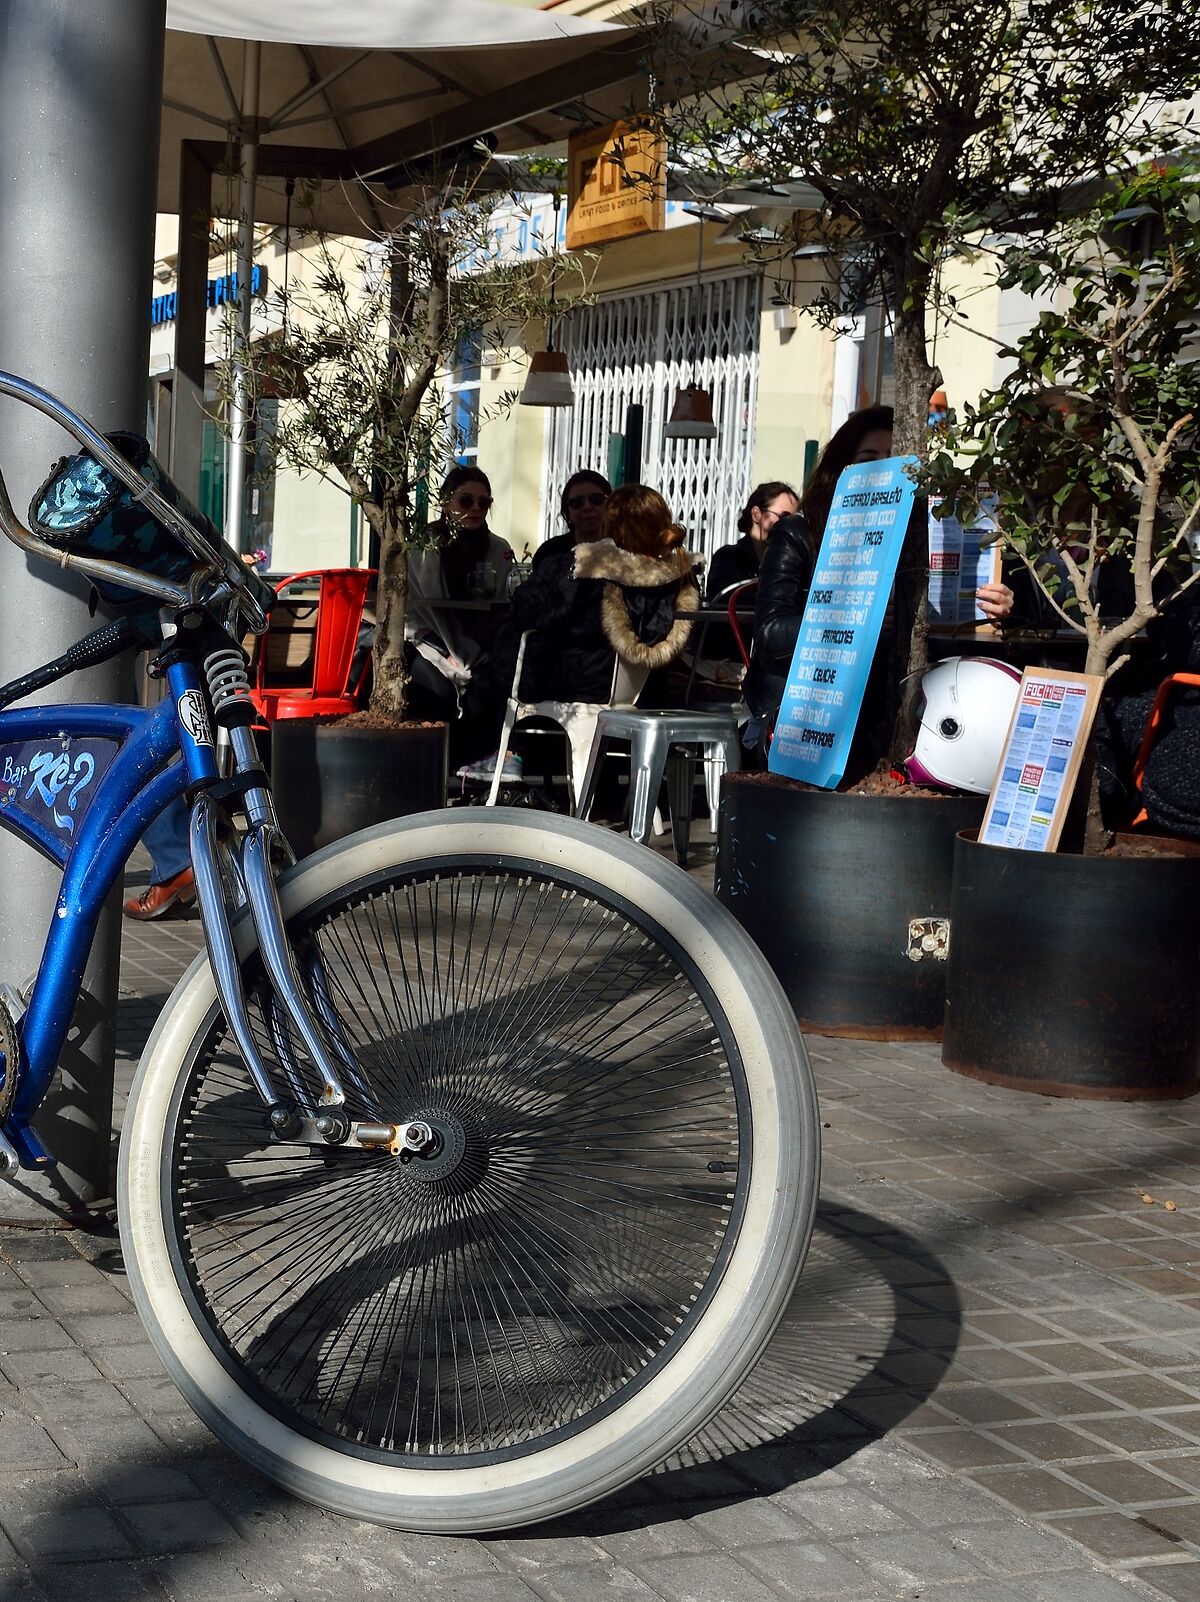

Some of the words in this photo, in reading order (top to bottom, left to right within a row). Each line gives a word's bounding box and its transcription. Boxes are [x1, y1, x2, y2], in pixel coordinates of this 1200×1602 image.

[595, 204, 610, 214] FOOD
[842, 491, 871, 507] ESTOFADO
[878, 510, 896, 525] COCO
[864, 531, 884, 545] TACOS
[821, 629, 854, 644] PATACONES
[813, 668, 836, 684] CEVICHE
[801, 728, 836, 748] EMPANADAS
[2, 756, 28, 788] Bar
